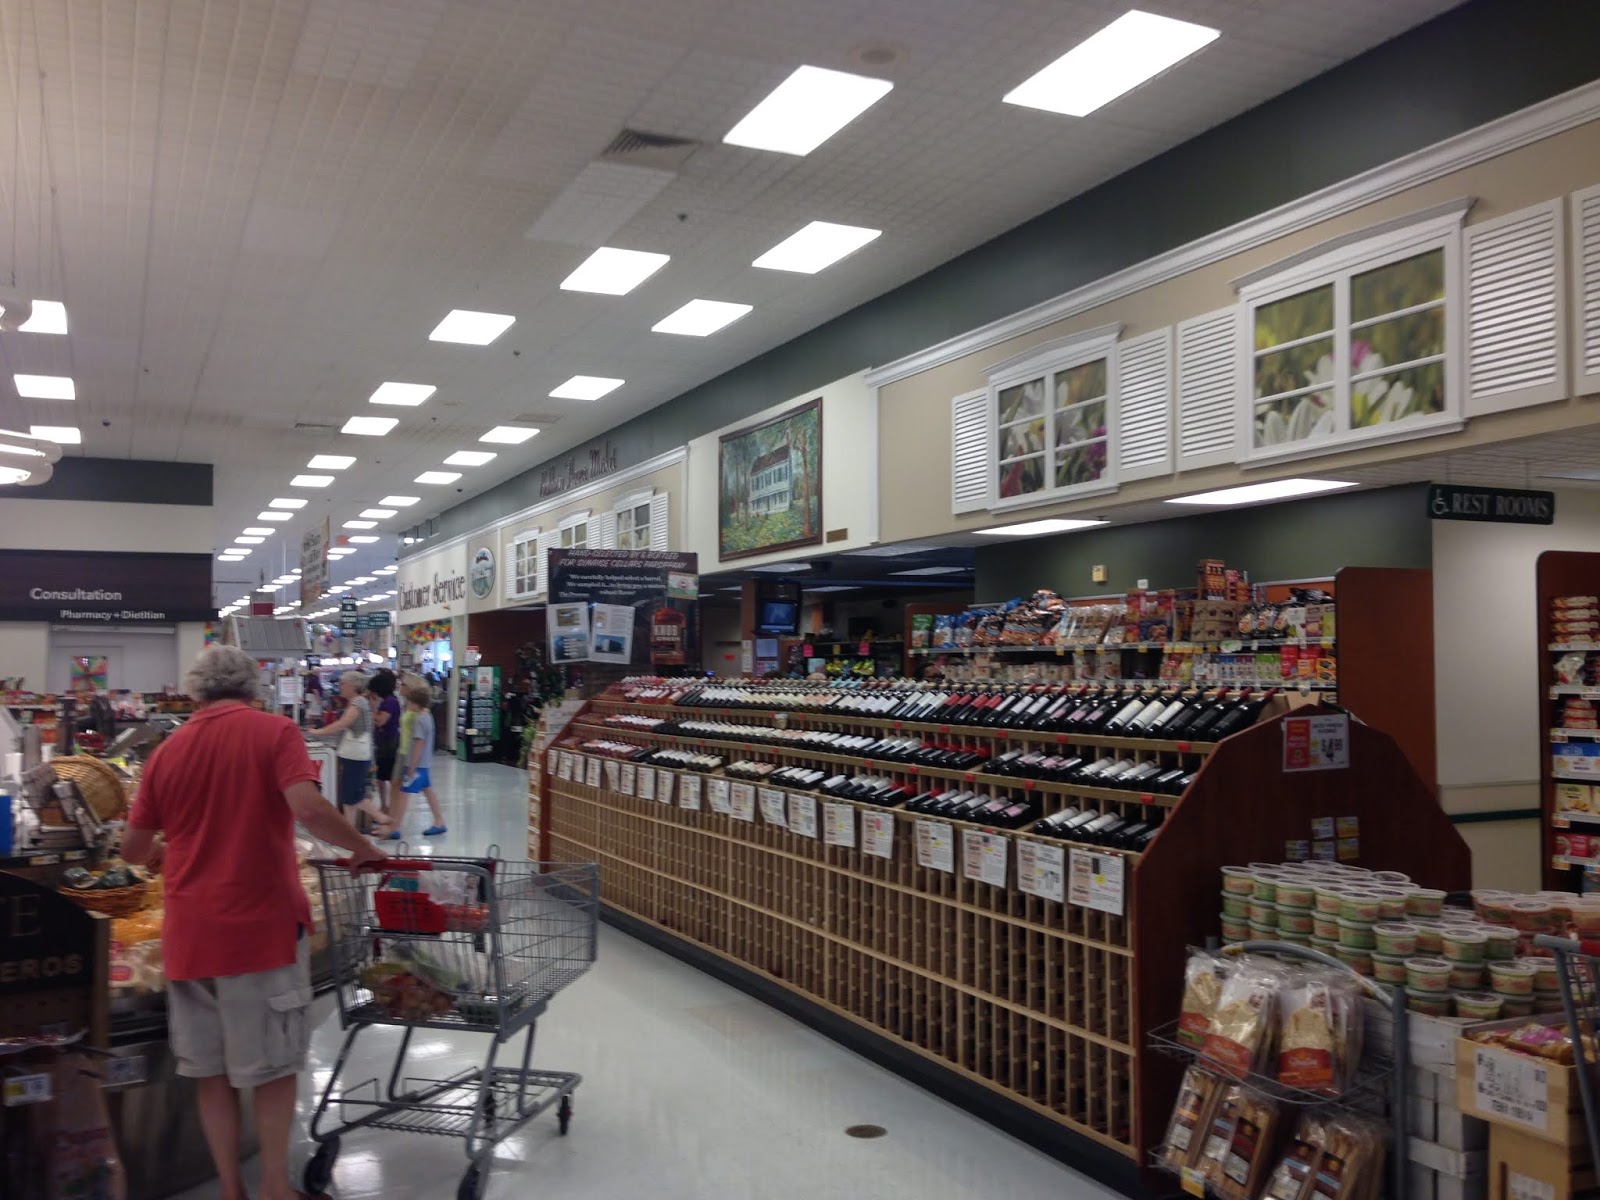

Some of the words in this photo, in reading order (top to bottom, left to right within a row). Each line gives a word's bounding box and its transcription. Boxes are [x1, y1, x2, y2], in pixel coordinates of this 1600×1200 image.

[1452, 493, 1490, 515] REST
[1495, 496, 1549, 518] ROOMS
[559, 558, 575, 566] FOR
[577, 559, 610, 567] SUNRISE
[611, 560, 642, 568] CELLARS
[644, 561, 688, 570] PARSIPPANY
[29, 587, 122, 601] Consultation
[400, 583, 430, 612] Customer
[433, 571, 466, 604] Service
[60, 610, 113, 620] Pharmacy
[121, 610, 166, 619] Dietitian
[653, 624, 678, 636] KNOB
